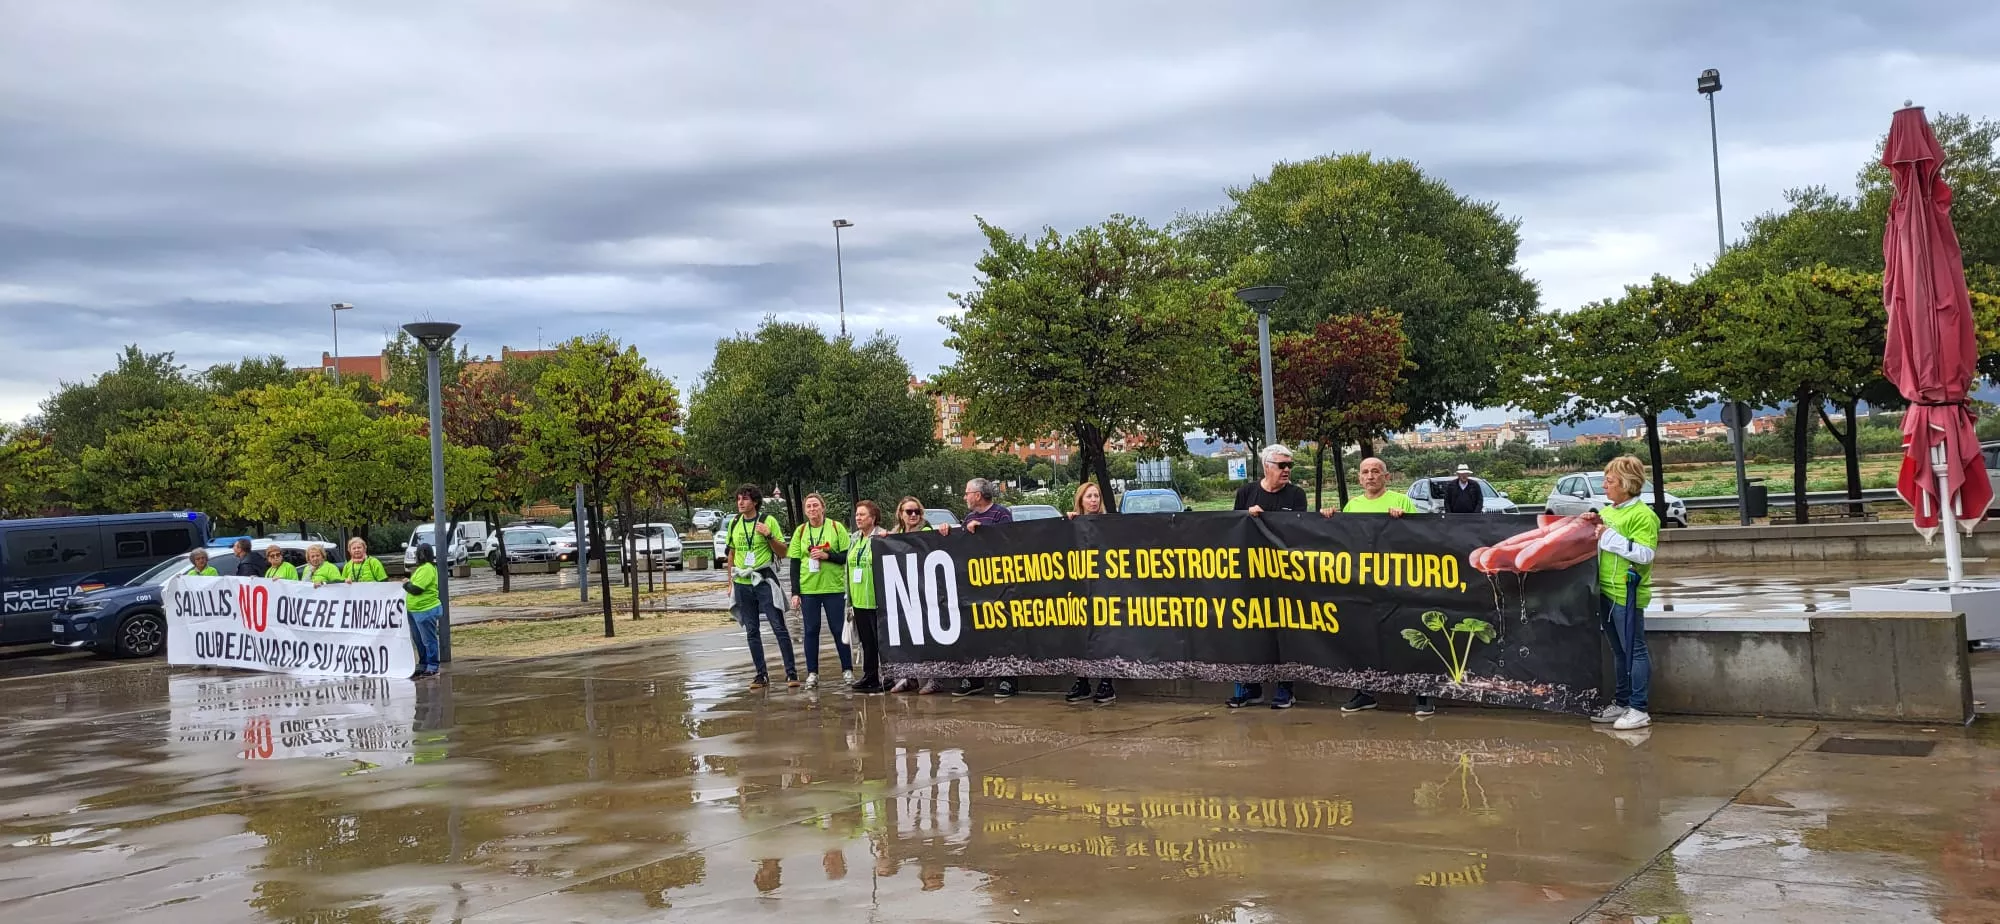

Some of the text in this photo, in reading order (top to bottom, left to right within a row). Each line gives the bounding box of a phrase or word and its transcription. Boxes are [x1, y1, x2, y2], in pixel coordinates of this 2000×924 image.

[967, 547, 1467, 593] QUEREMOS QUE SE DESTROCE NUESTRO FUTURO,
[4, 585, 84, 602] POLICIA
[4, 598, 64, 612] NACIO
[174, 584, 405, 632] SALILLAS, NO QUIERE EMBALSES
[882, 549, 962, 647] NO
[971, 592, 1340, 634] LOS REGADÍOS DE HUERTO Y SALILLAS
[259, 637, 309, 668] VACIO
[308, 642, 333, 670] SU
[333, 644, 389, 674] PUEBLO
